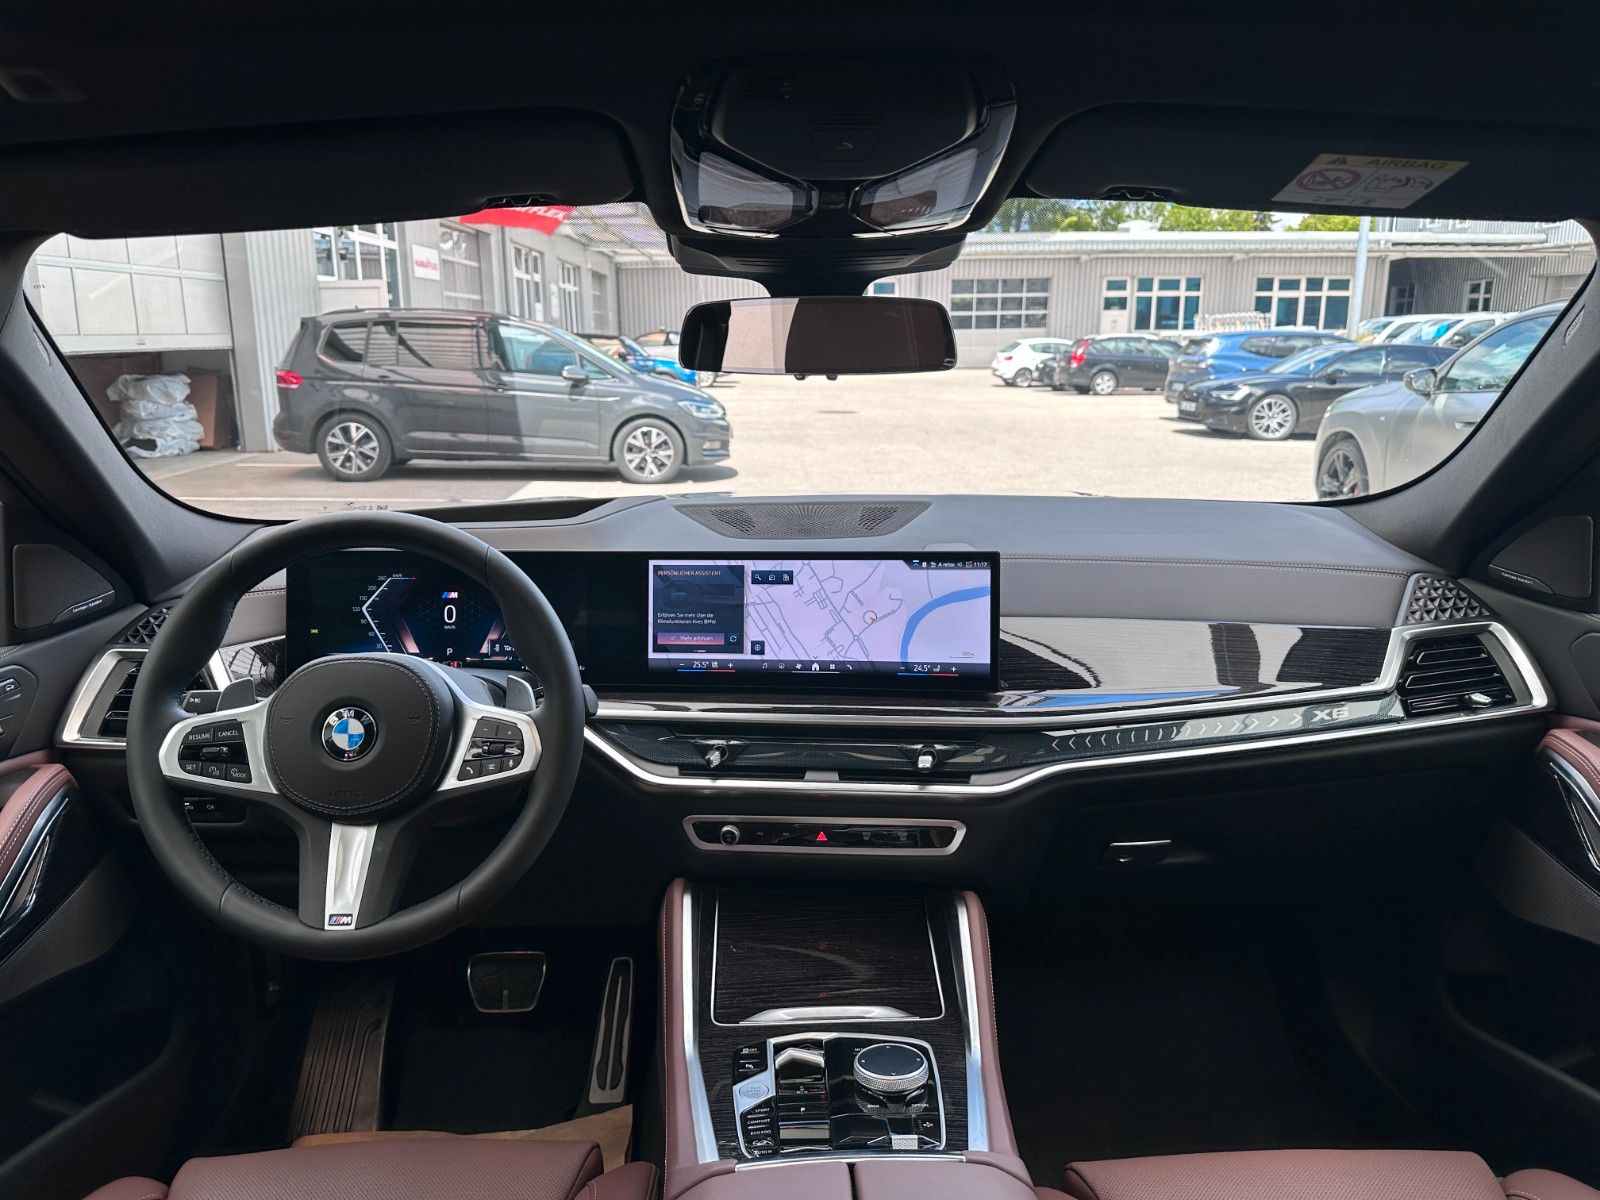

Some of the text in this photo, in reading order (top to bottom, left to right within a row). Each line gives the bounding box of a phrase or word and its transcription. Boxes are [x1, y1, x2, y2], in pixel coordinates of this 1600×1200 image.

[1368, 159, 1447, 170] AIRBAG
[444, 605, 456, 623] 0
[329, 709, 372, 726] BMW
[1311, 707, 1349, 722] X6
[218, 729, 239, 737] CANCEL
